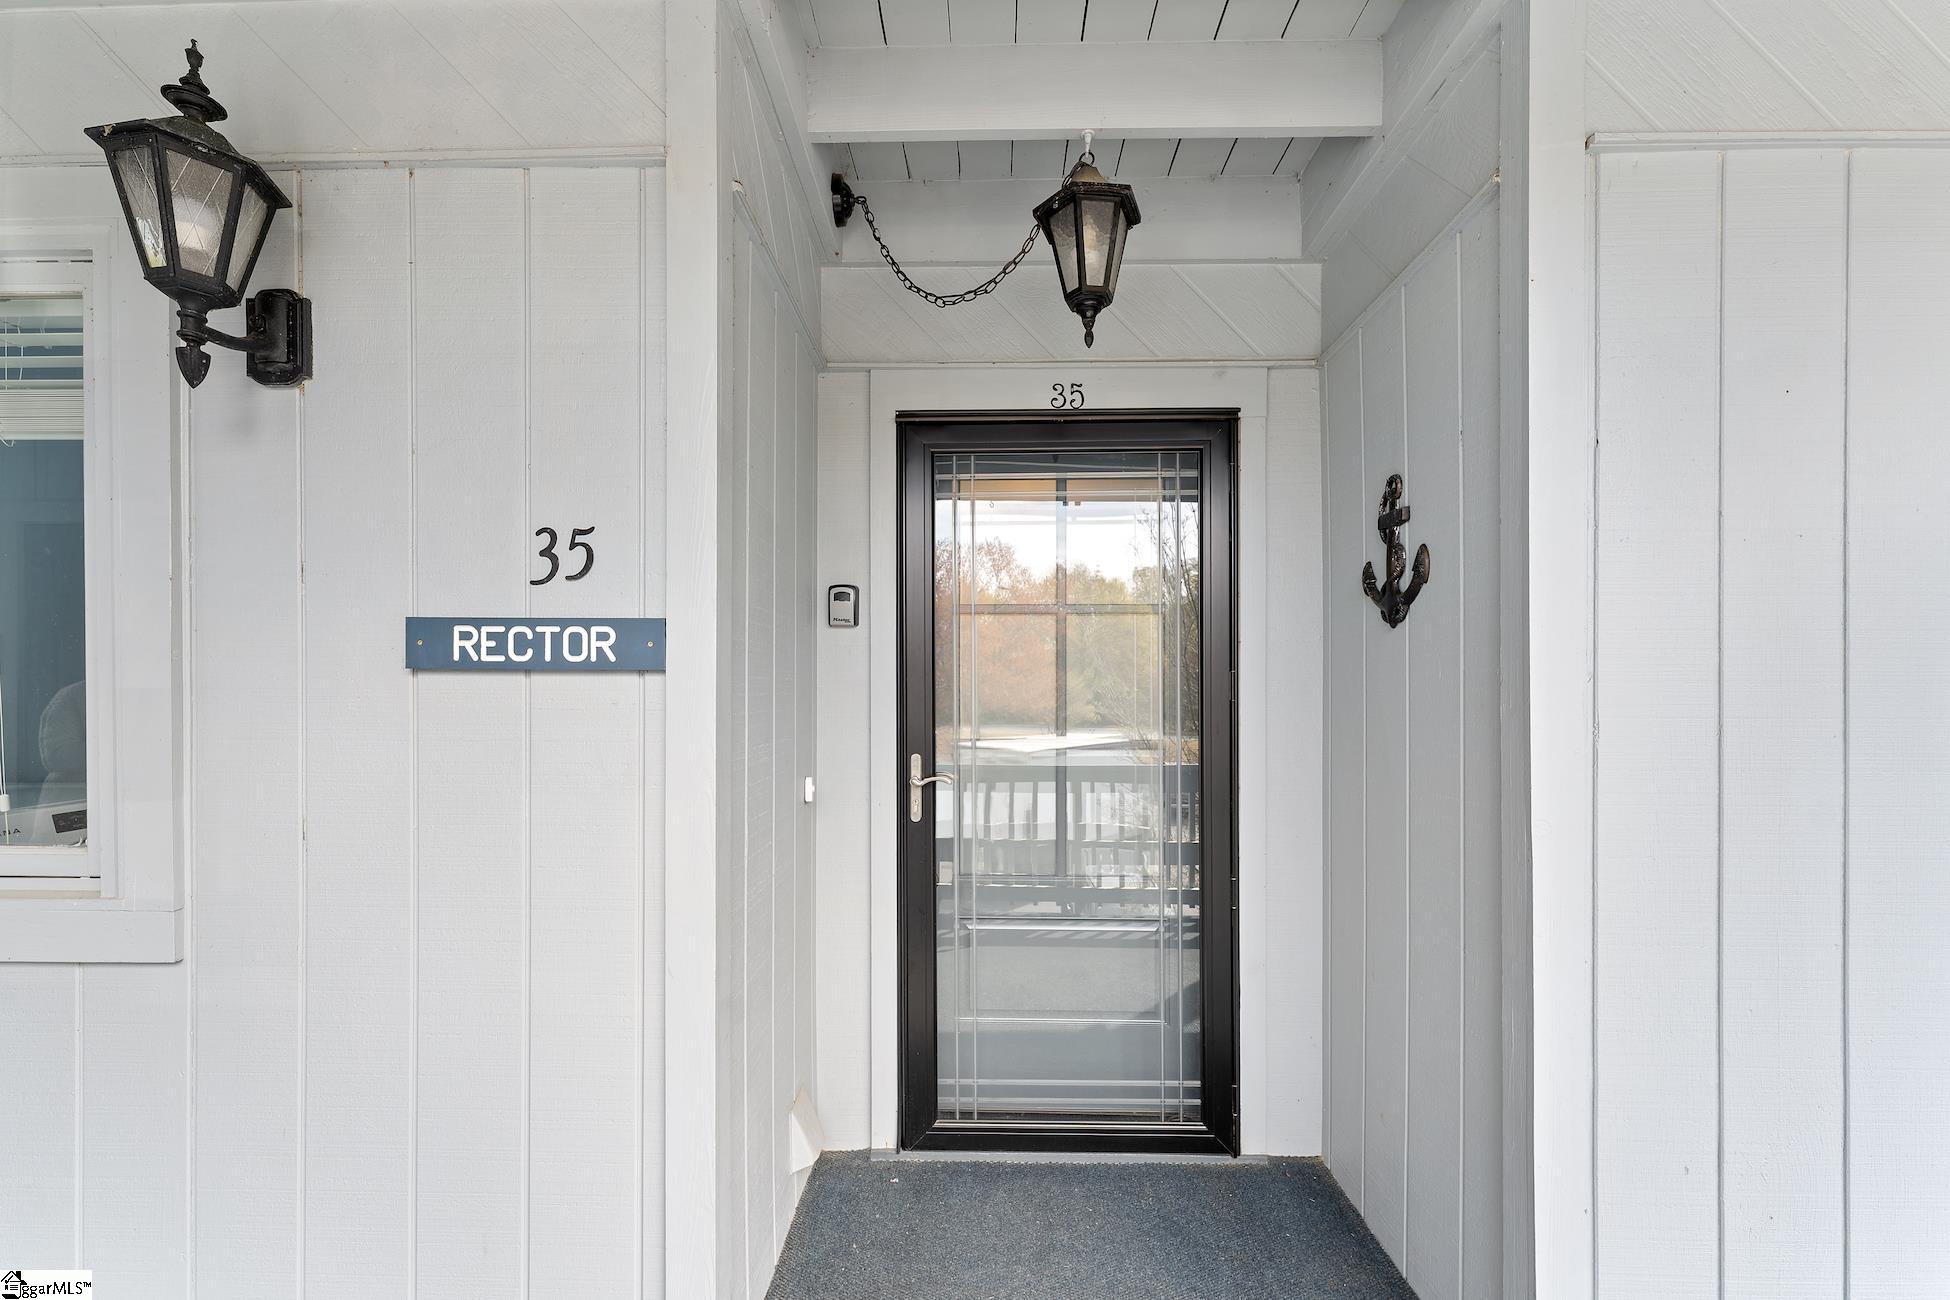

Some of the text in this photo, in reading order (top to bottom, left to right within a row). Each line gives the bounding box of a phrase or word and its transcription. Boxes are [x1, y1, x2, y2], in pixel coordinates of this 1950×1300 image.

[1050, 383, 1085, 409] 35
[530, 526, 596, 585] 35
[452, 624, 617, 663] RECTOR
